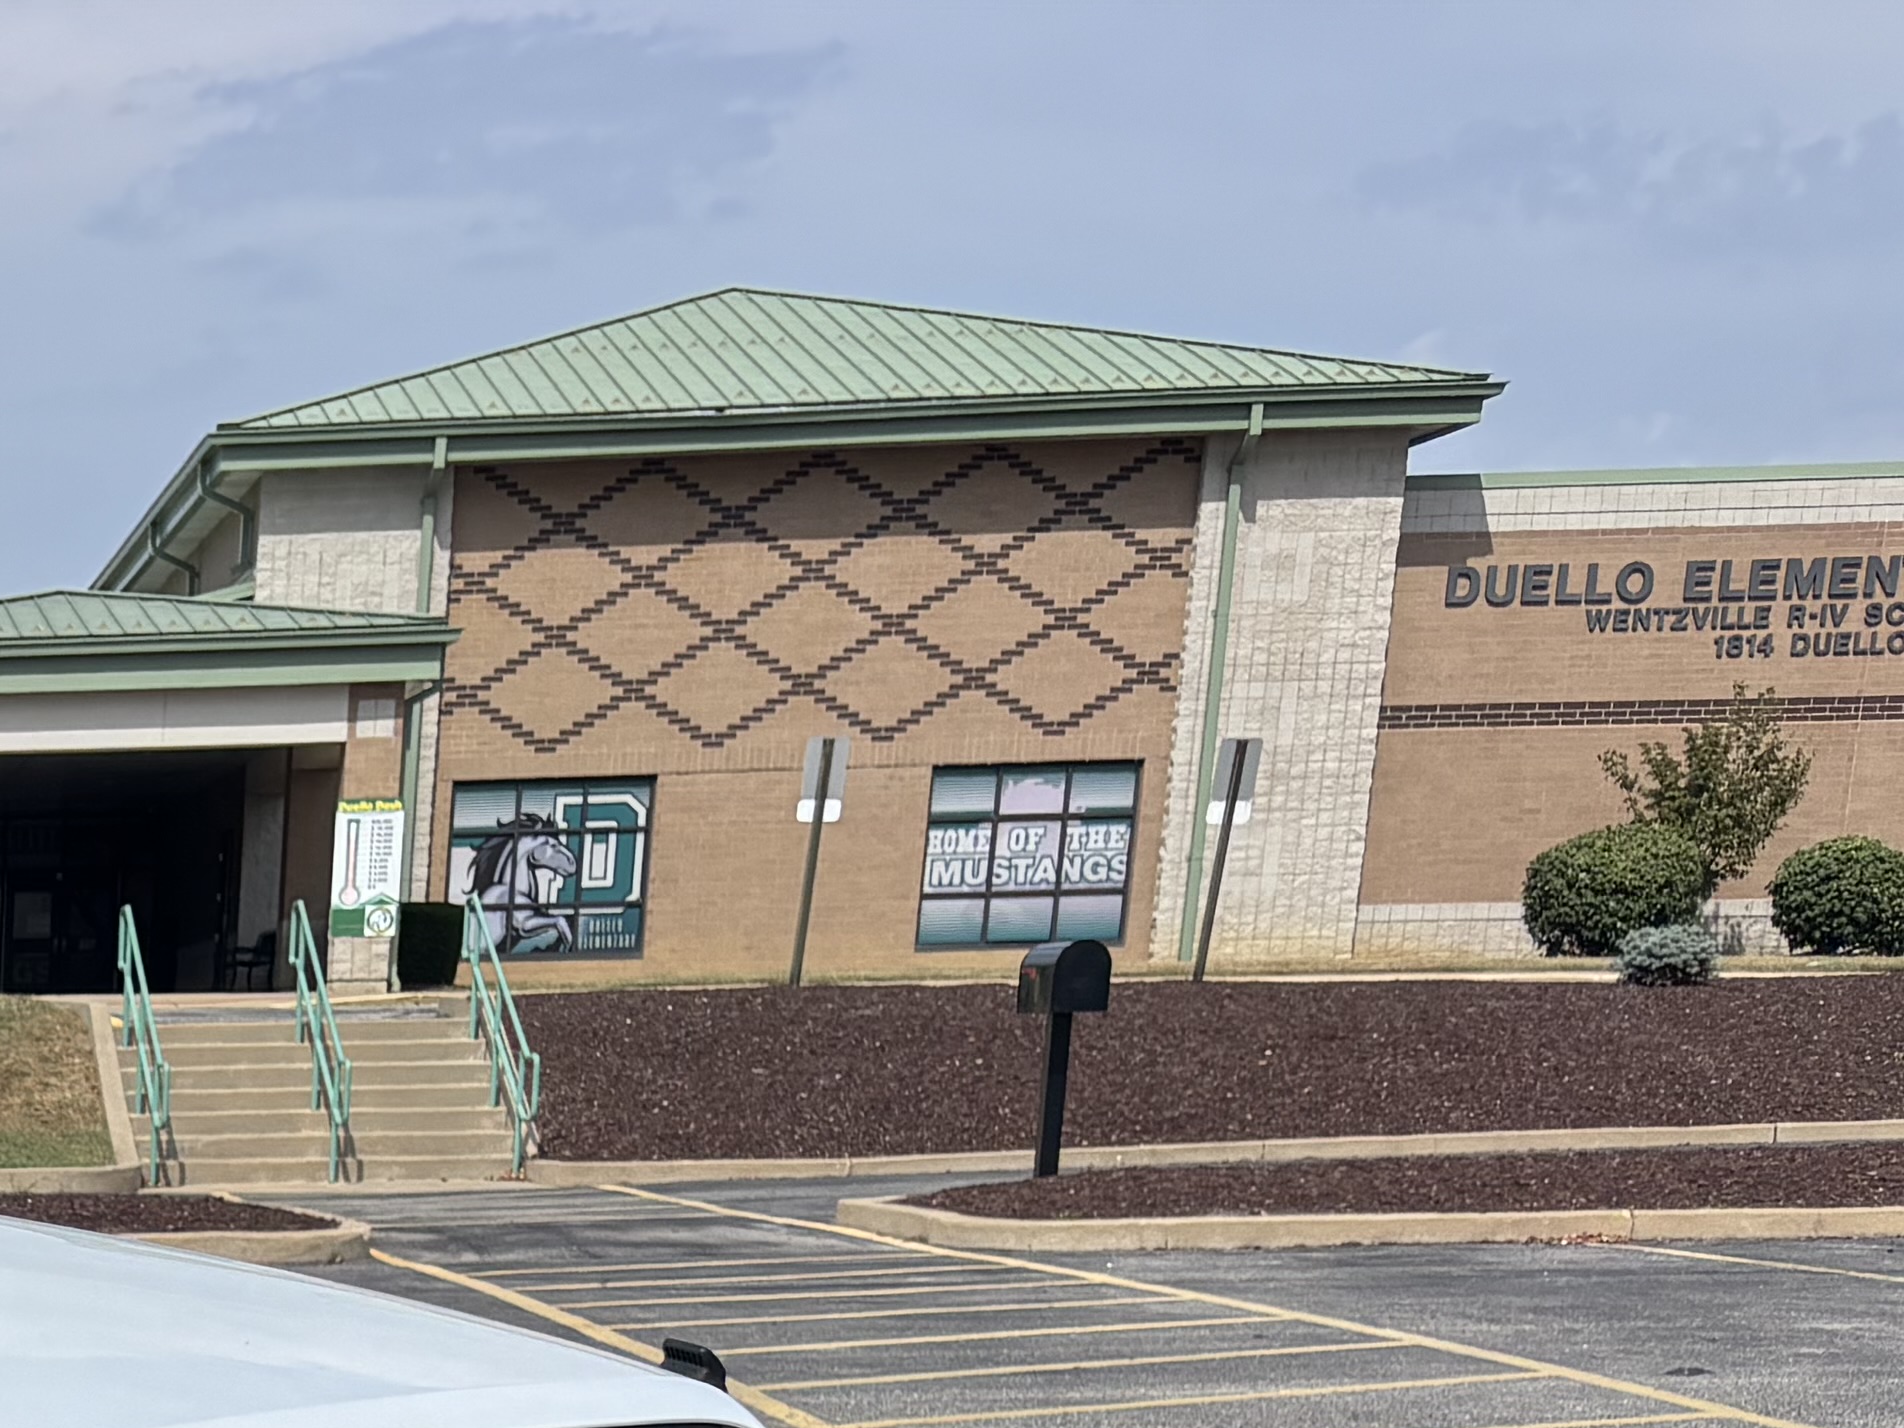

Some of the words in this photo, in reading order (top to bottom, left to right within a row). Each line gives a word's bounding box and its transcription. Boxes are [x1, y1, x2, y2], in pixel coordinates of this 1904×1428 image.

[1445, 561, 1655, 608] DUELLO
[1683, 555, 1904, 603] ELEMEN
[1585, 604, 1772, 633] WENTZVILLE
[1787, 602, 1850, 630] R-IV
[1713, 632, 1775, 660] 1814
[1789, 630, 1904, 658] DUELLO
[927, 826, 992, 855] HOME
[1008, 826, 1046, 852] OF
[1065, 823, 1130, 851] THE
[928, 852, 1129, 888] MUSTANGS
